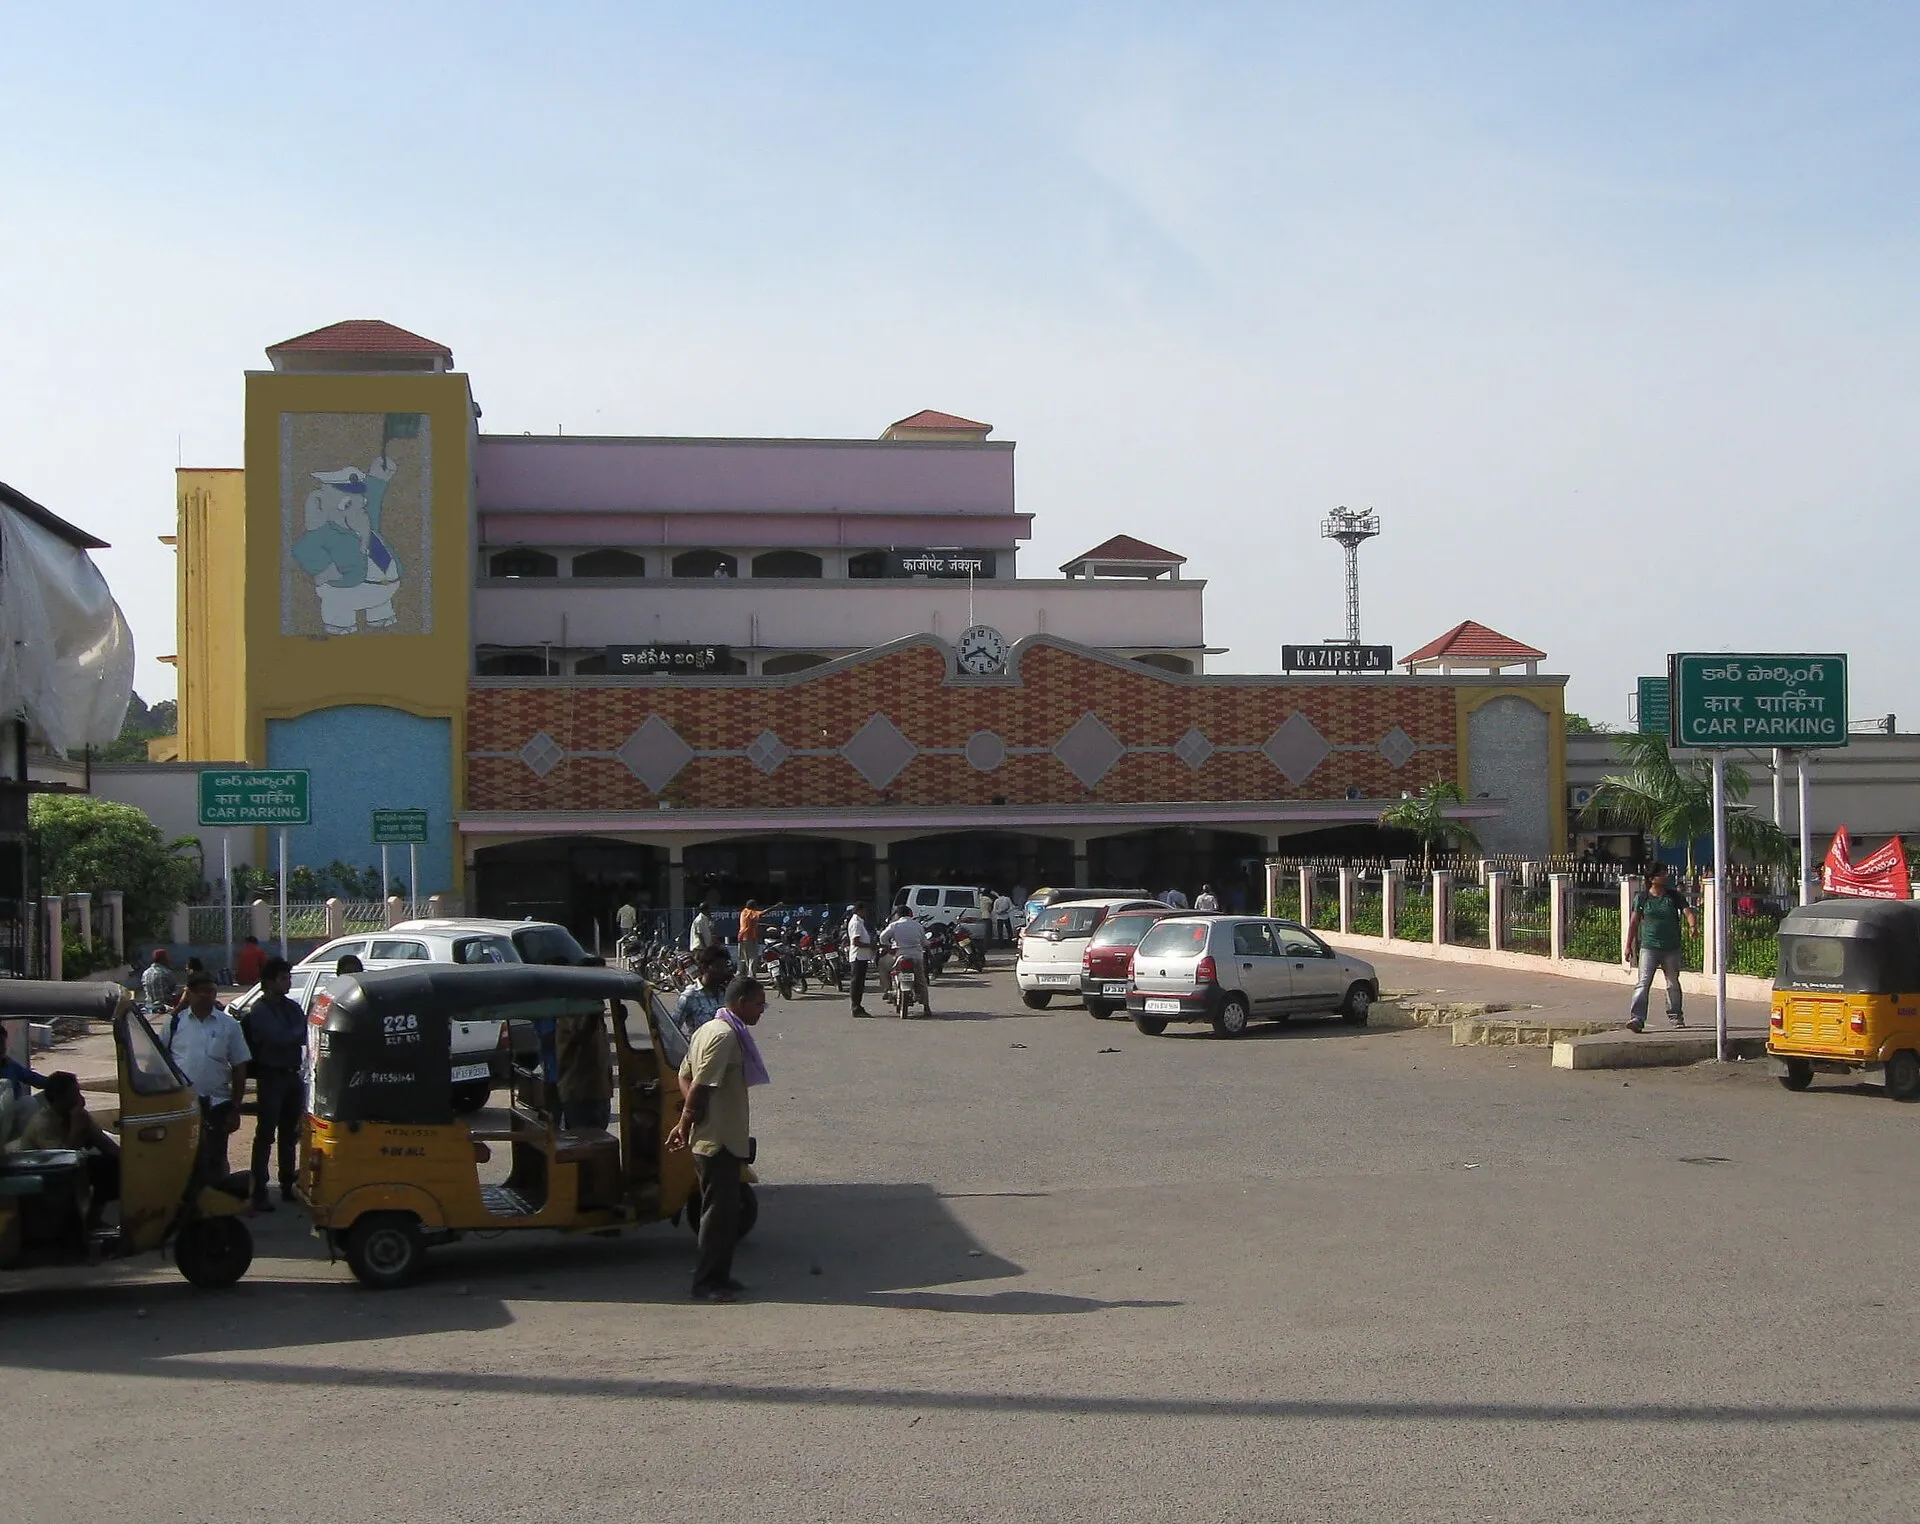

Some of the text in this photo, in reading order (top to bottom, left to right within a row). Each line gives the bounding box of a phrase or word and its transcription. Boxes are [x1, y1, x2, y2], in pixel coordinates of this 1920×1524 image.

[903, 554, 982, 572] काजीपेट जंक्शन
[1296, 650, 1361, 667] KAZIPET
[1702, 664, 1742, 681] కార్
[1703, 689, 1826, 713] कार पार्किंग
[1692, 717, 1836, 735] CAR PARKING
[214, 794, 241, 805] कार
[206, 807, 301, 818] CAR PARKING
[383, 1014, 418, 1033] 228
